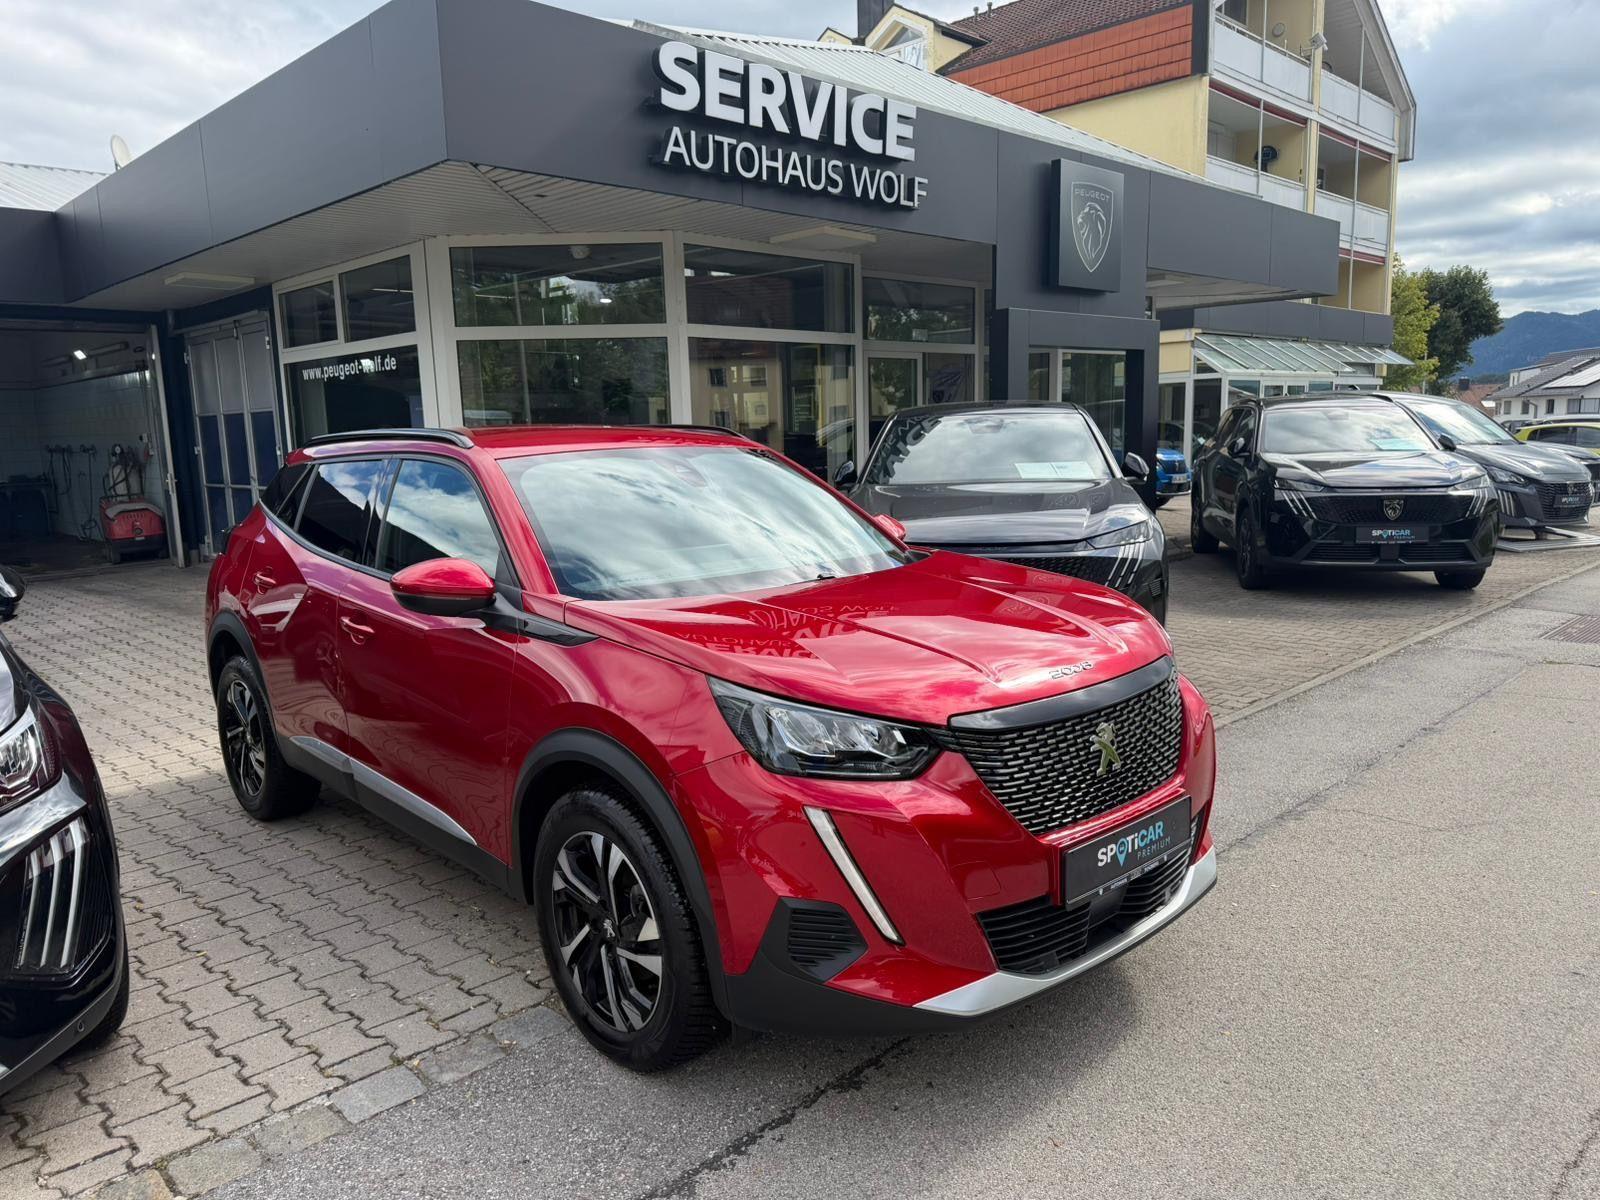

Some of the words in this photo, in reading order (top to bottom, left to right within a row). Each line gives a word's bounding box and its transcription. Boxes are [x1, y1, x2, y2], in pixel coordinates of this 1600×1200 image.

[658, 40, 917, 161] SERVICE
[663, 126, 843, 194] AUTOHAUS
[850, 163, 928, 208] WOLF
[1074, 189, 1110, 202] PEUGEOT
[302, 354, 397, 381] www.peugeot-wolf.de
[1137, 836, 1171, 860] PREMIUM
